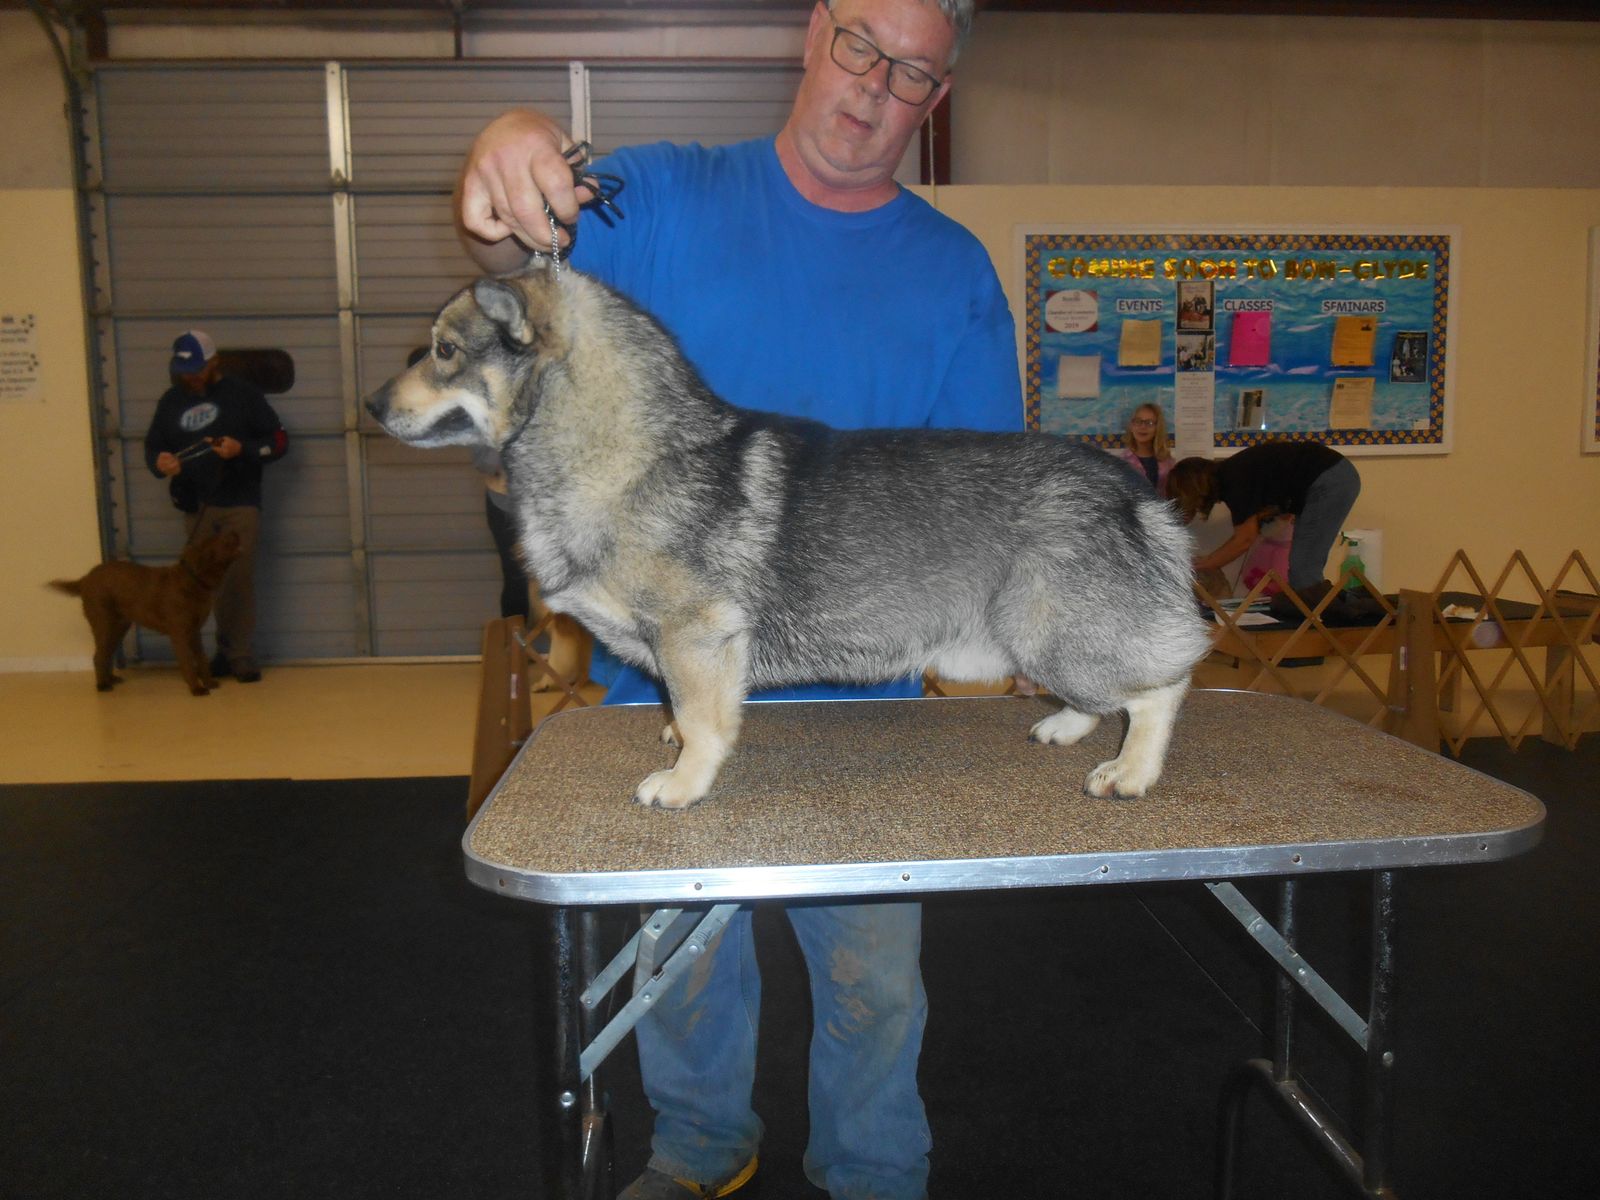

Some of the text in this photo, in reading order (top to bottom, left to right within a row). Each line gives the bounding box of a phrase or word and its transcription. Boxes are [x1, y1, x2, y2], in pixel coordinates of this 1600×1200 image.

[1047, 256, 1155, 279] COMING
[1163, 257, 1237, 280] SOON
[1242, 258, 1278, 280] TO
[1118, 301, 1162, 311] EVENTS
[1224, 301, 1273, 311] CLASSES
[1323, 301, 1384, 312] SEMINARS
